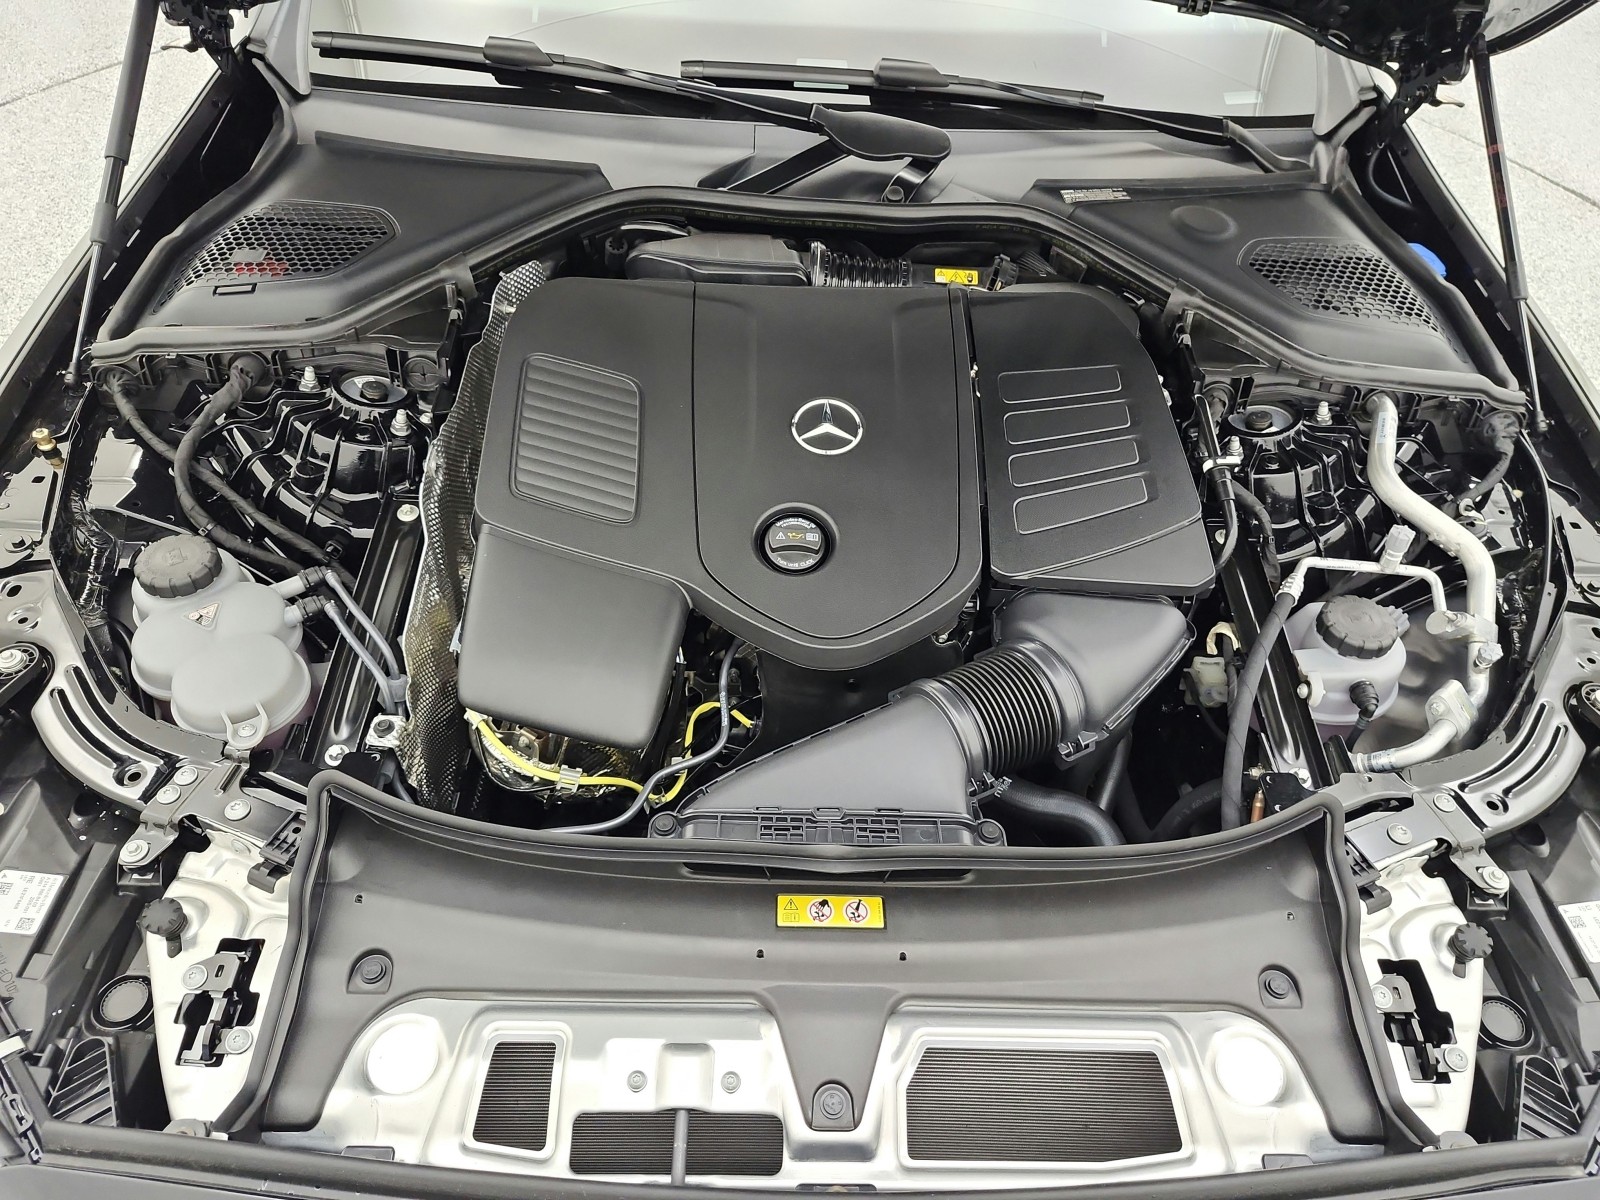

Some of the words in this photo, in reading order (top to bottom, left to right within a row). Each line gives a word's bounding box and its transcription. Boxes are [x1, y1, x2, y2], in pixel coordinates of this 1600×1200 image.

[775, 518, 810, 526] Mercedes-Benz
[777, 557, 787, 566] Turn
[800, 558, 815, 567] CLICK
